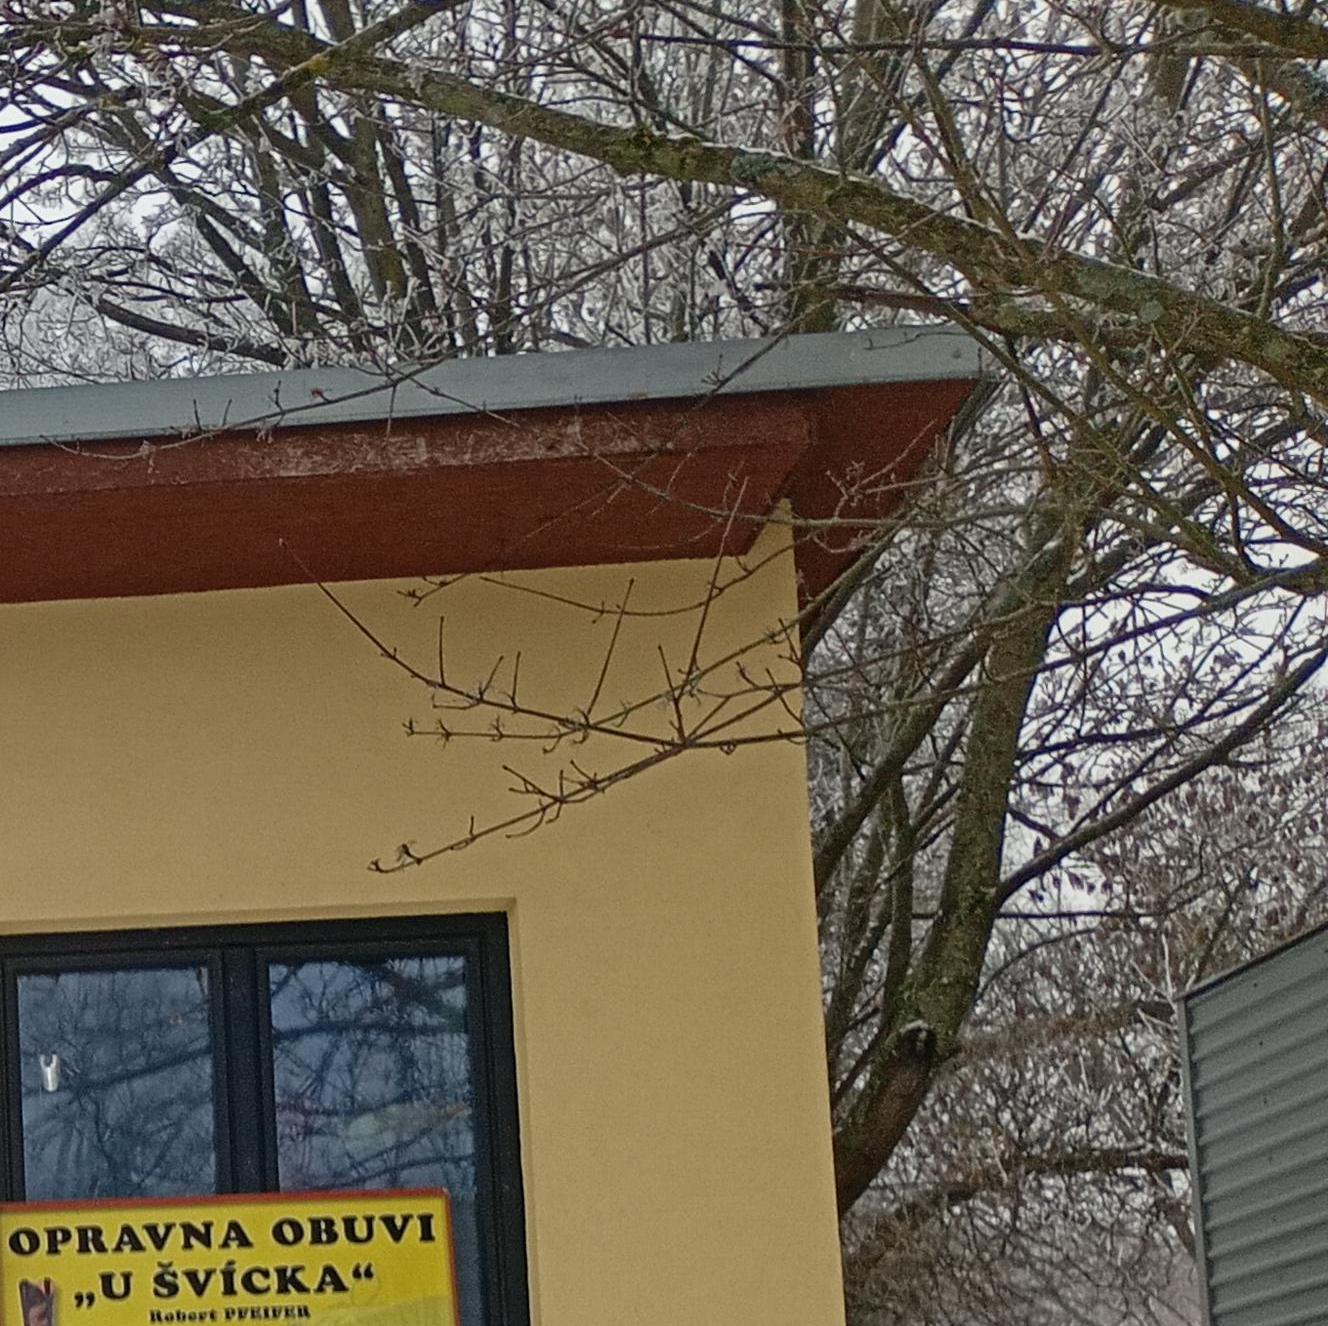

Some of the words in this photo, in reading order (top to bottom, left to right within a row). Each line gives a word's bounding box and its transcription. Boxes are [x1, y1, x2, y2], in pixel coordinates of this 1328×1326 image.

[8, 1219, 254, 1256] OPRAVNA
[272, 1212, 436, 1246] OBUVI
[149, 1306, 218, 1324] Robert
[224, 1303, 311, 1322] PFEIFER
